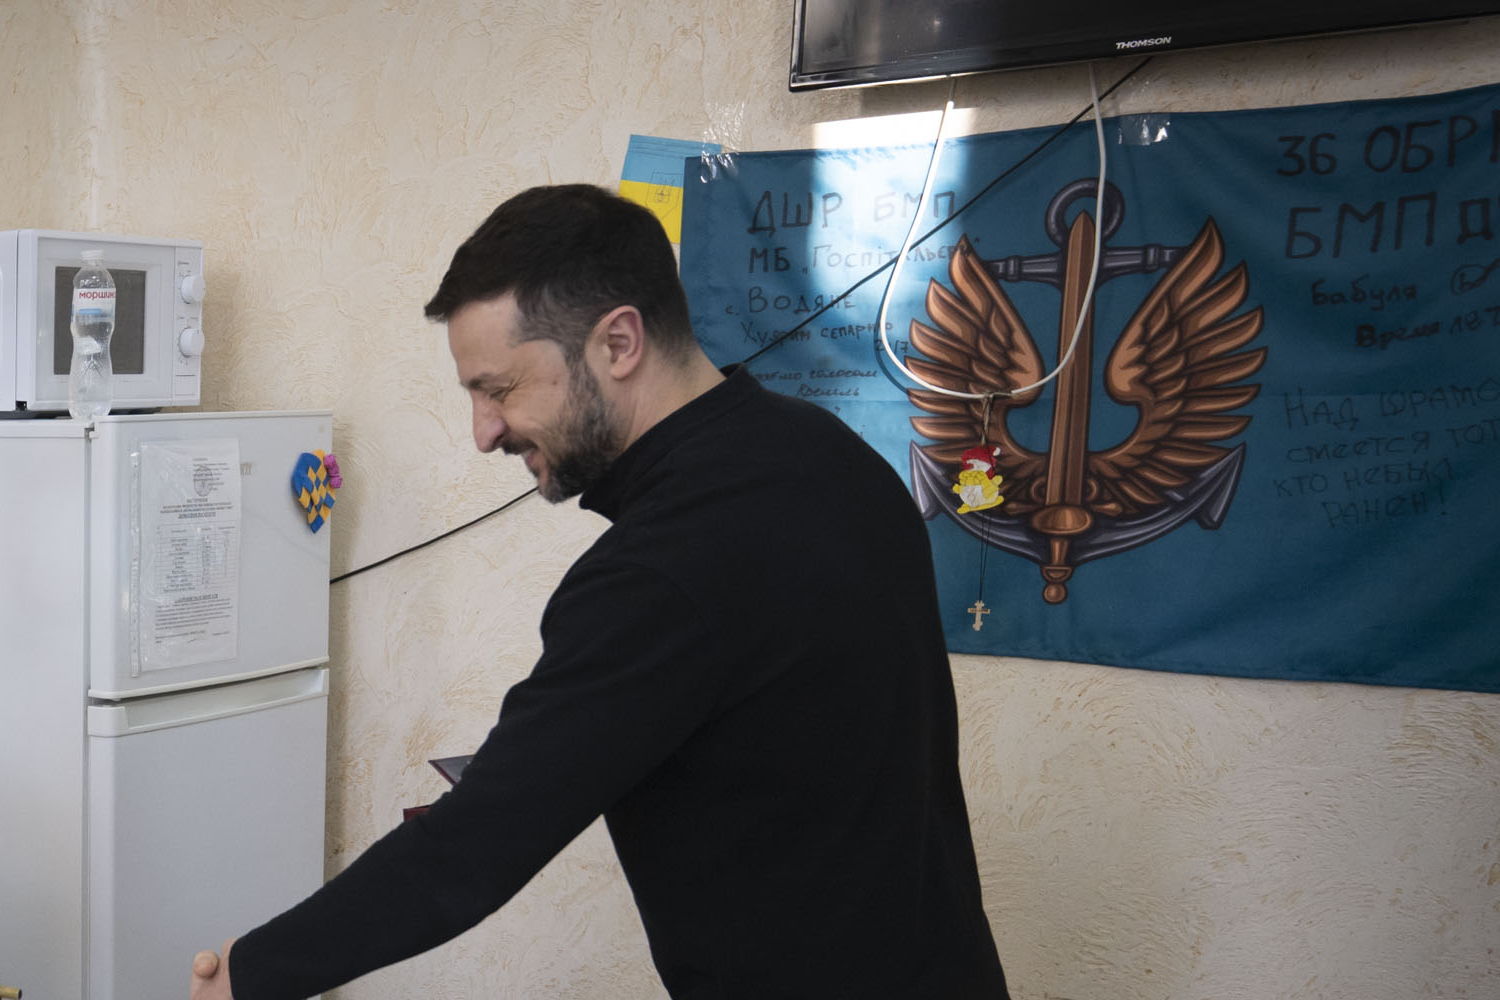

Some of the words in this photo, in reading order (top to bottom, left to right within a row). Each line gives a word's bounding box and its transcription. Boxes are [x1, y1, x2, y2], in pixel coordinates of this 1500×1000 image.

[1115, 36, 1172, 50] THOMSON
[1275, 132, 1337, 177] 36
[747, 190, 843, 237] ДШР
[1285, 191, 1437, 259] БМП
[748, 247, 791, 273] МБ
